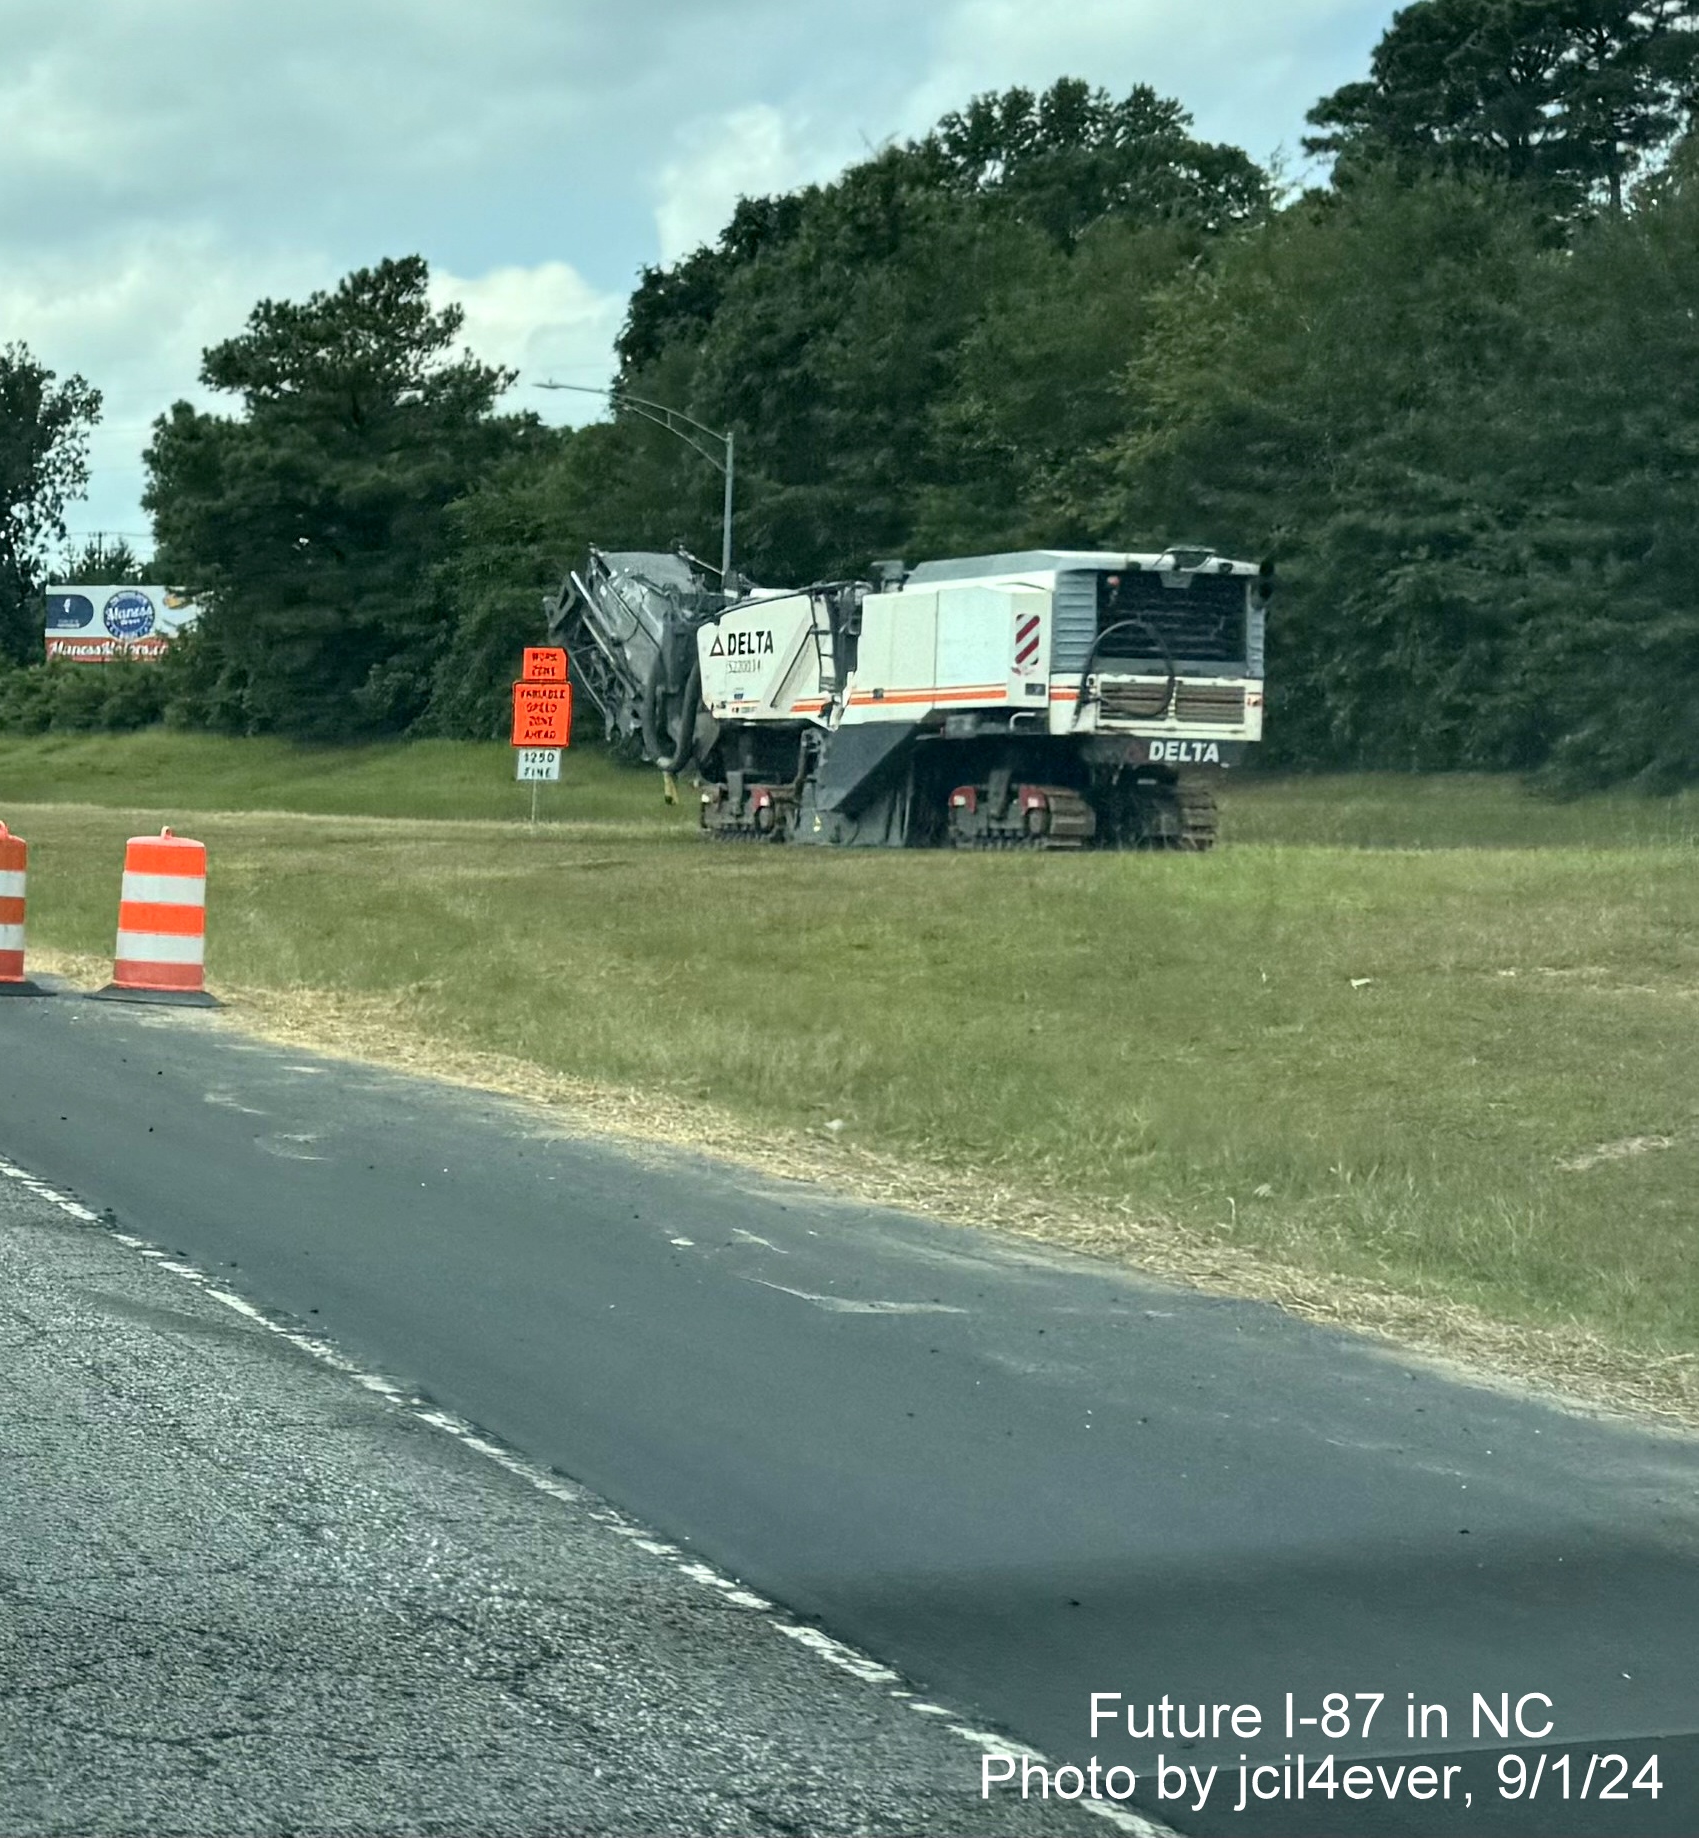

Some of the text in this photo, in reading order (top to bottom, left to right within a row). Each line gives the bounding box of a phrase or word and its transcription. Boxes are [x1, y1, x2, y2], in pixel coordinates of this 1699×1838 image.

[727, 630, 774, 656] DELTA
[520, 689, 566, 700] VARIABLE
[526, 702, 558, 713] SPEED
[523, 729, 557, 740] AHEAD
[1148, 740, 1220, 763] DELTA
